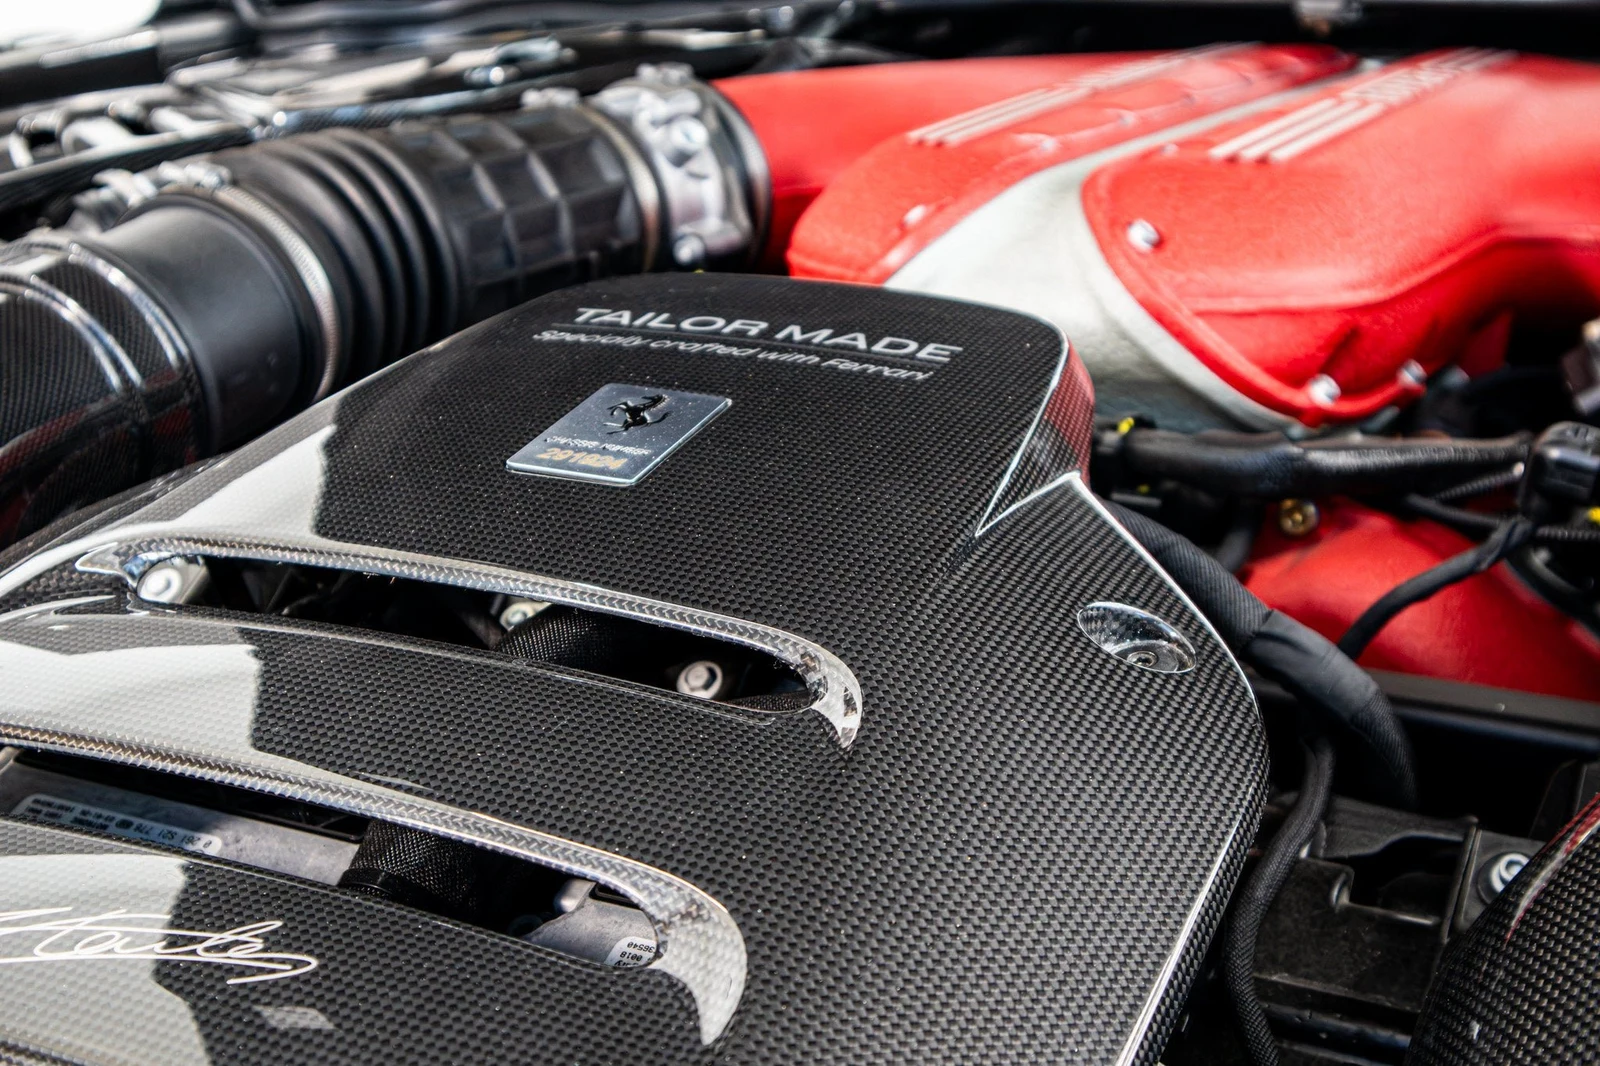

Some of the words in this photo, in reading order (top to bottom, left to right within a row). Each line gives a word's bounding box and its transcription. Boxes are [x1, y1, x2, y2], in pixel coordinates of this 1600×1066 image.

[532, 329, 652, 347] Specially
[649, 338, 761, 357] crafted
[757, 349, 821, 365] with
[815, 357, 935, 380] Ferrari
[573, 307, 769, 336] TAILOR
[774, 324, 963, 362] MADE
